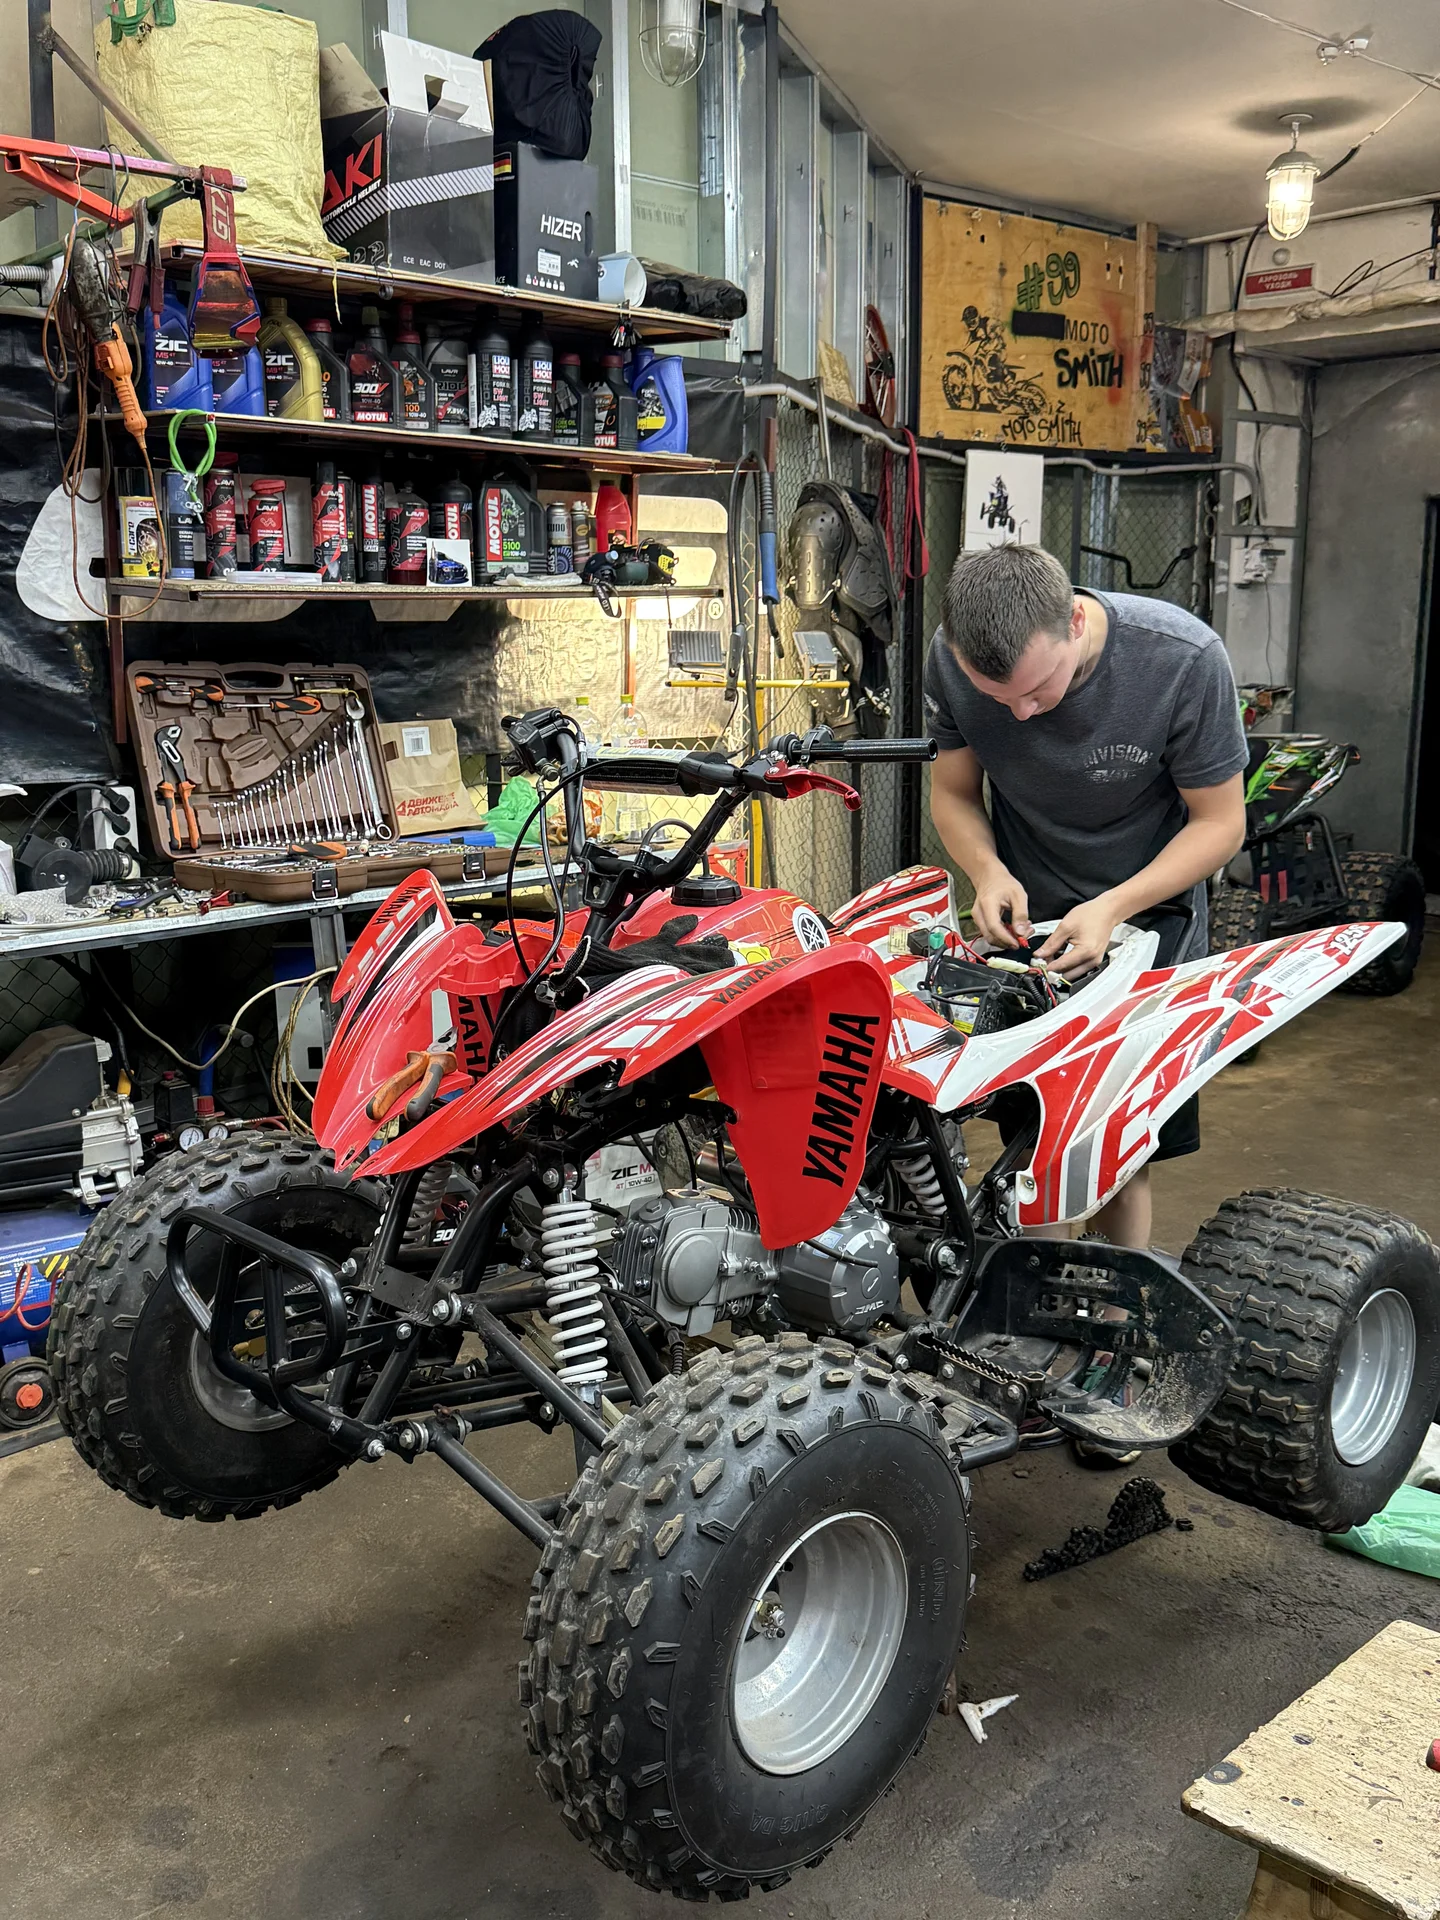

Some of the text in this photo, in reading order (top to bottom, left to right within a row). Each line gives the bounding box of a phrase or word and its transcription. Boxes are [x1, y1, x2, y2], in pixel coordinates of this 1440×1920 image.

[357, 179, 381, 201] HELMET
[540, 214, 582, 241] HIZER
[403, 256, 446, 270] ECE EAC DOT
[1016, 251, 1081, 312] #99
[1065, 319, 1109, 345] MOTO
[155, 339, 188, 353] ZIC
[265, 354, 294, 366] ZIC
[352, 382, 390, 395] 300V
[355, 412, 388, 423] MOTUL
[1001, 414, 1036, 438] MOTO
[256, 504, 279, 512] LAVR
[363, 486, 377, 537] MOTUL
[487, 496, 501, 556] MOTUL
[502, 541, 521, 551] 5100
[371, 886, 427, 926] YAMAHA
[713, 957, 796, 1004] YAMAHA
[801, 1011, 881, 1188] YAMAHA
[611, 1163, 656, 1180] ZIC M
[627, 1177, 653, 1187] 10W-40
